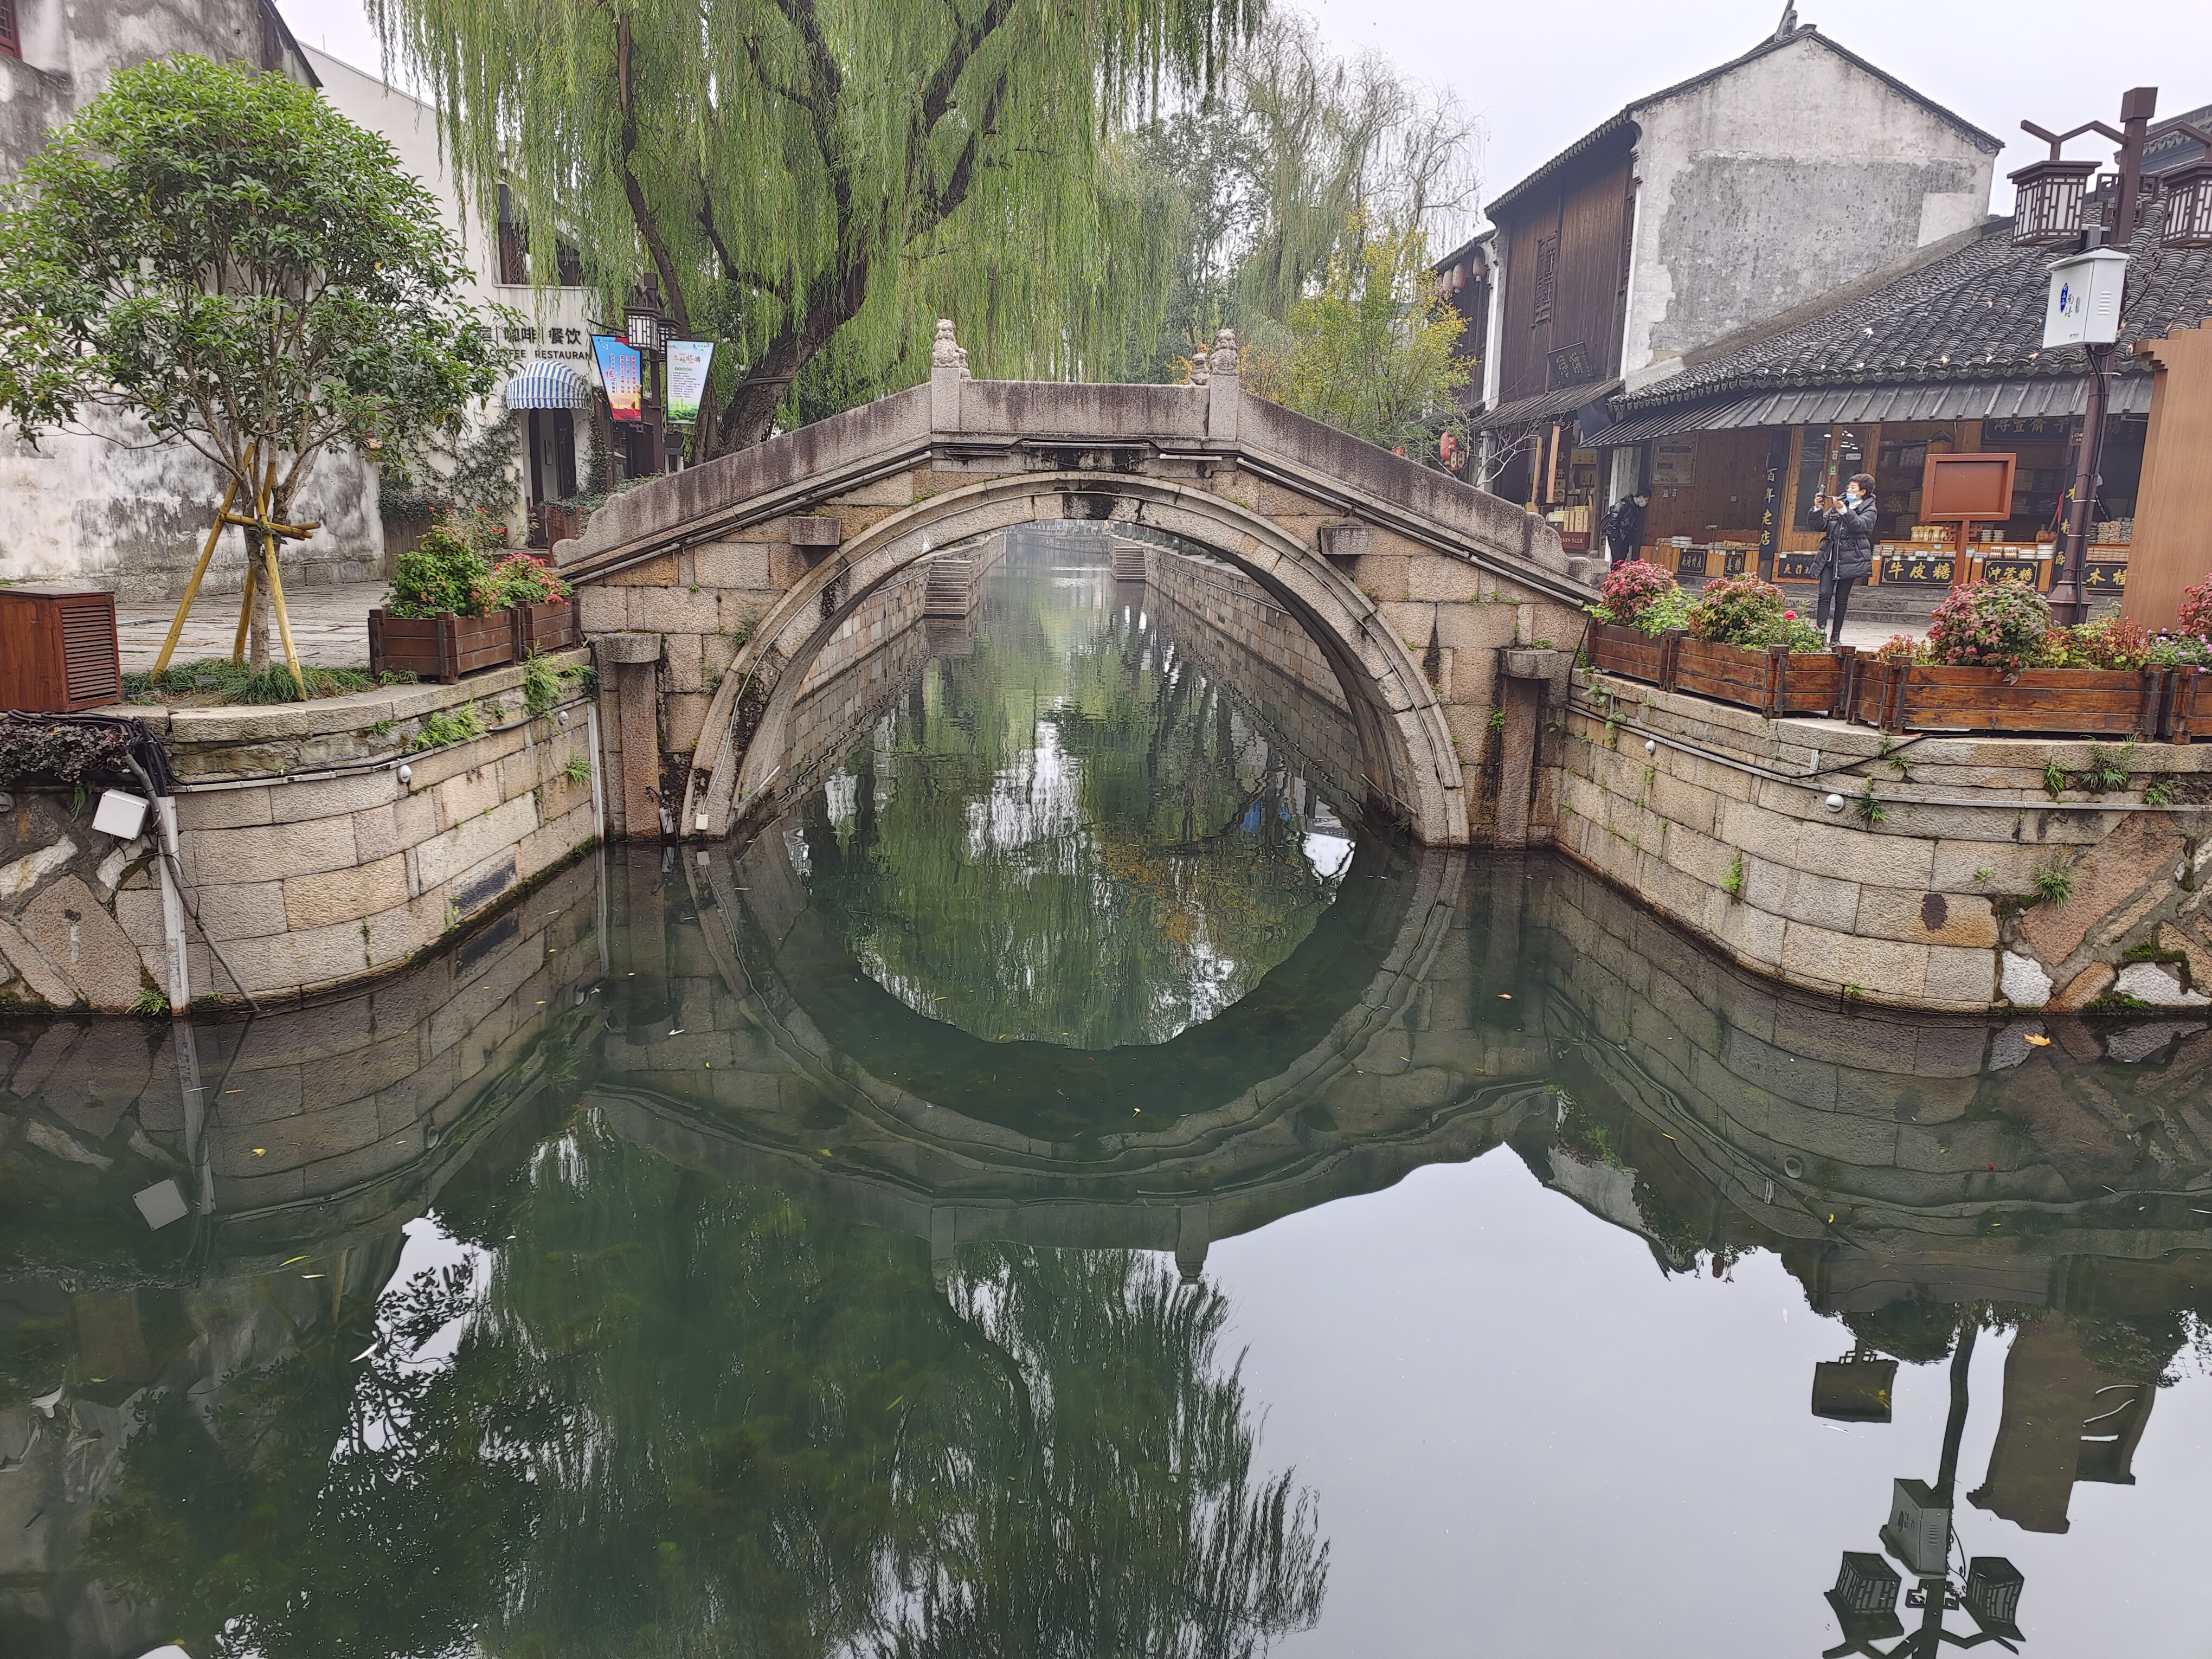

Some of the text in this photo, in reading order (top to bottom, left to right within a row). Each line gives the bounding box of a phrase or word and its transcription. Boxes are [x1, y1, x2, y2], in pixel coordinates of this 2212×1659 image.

[549, 327, 581, 344] 餐饮
[490, 349, 526, 358] CFEE
[1760, 468, 1778, 545] 百年老店
[1888, 562, 1951, 580] 牛皮糖
